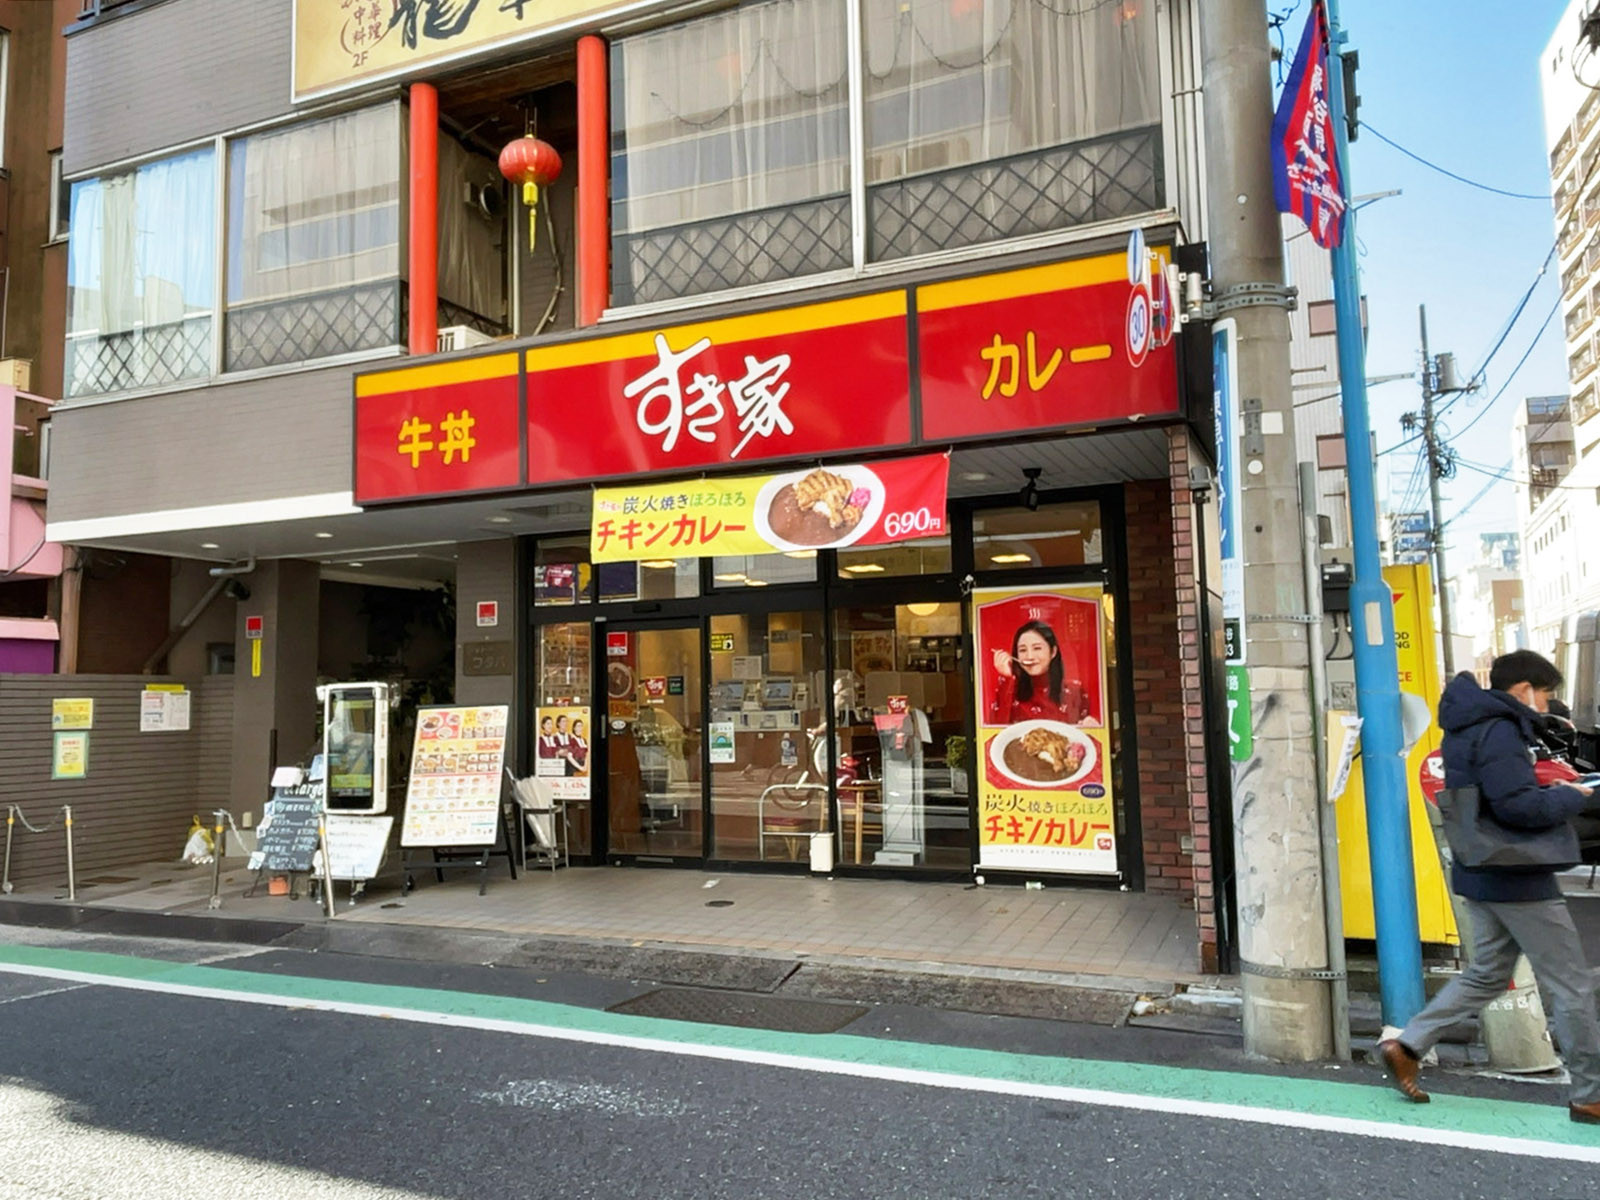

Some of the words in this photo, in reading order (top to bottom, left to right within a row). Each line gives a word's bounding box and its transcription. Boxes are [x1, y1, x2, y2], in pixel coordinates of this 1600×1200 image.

[352, 50, 369, 68] 2F
[1130, 304, 1145, 345] 30
[981, 331, 1113, 400] カレー
[624, 332, 794, 459] すき家
[398, 409, 476, 468] 牛丼
[622, 492, 746, 515] 炭火焼きほろほろ
[597, 513, 746, 552] チキンカレー
[884, 507, 941, 537] 690円
[985, 793, 1108, 816] 炭火焼きほろほろ
[985, 815, 1110, 846] チキンカレー
